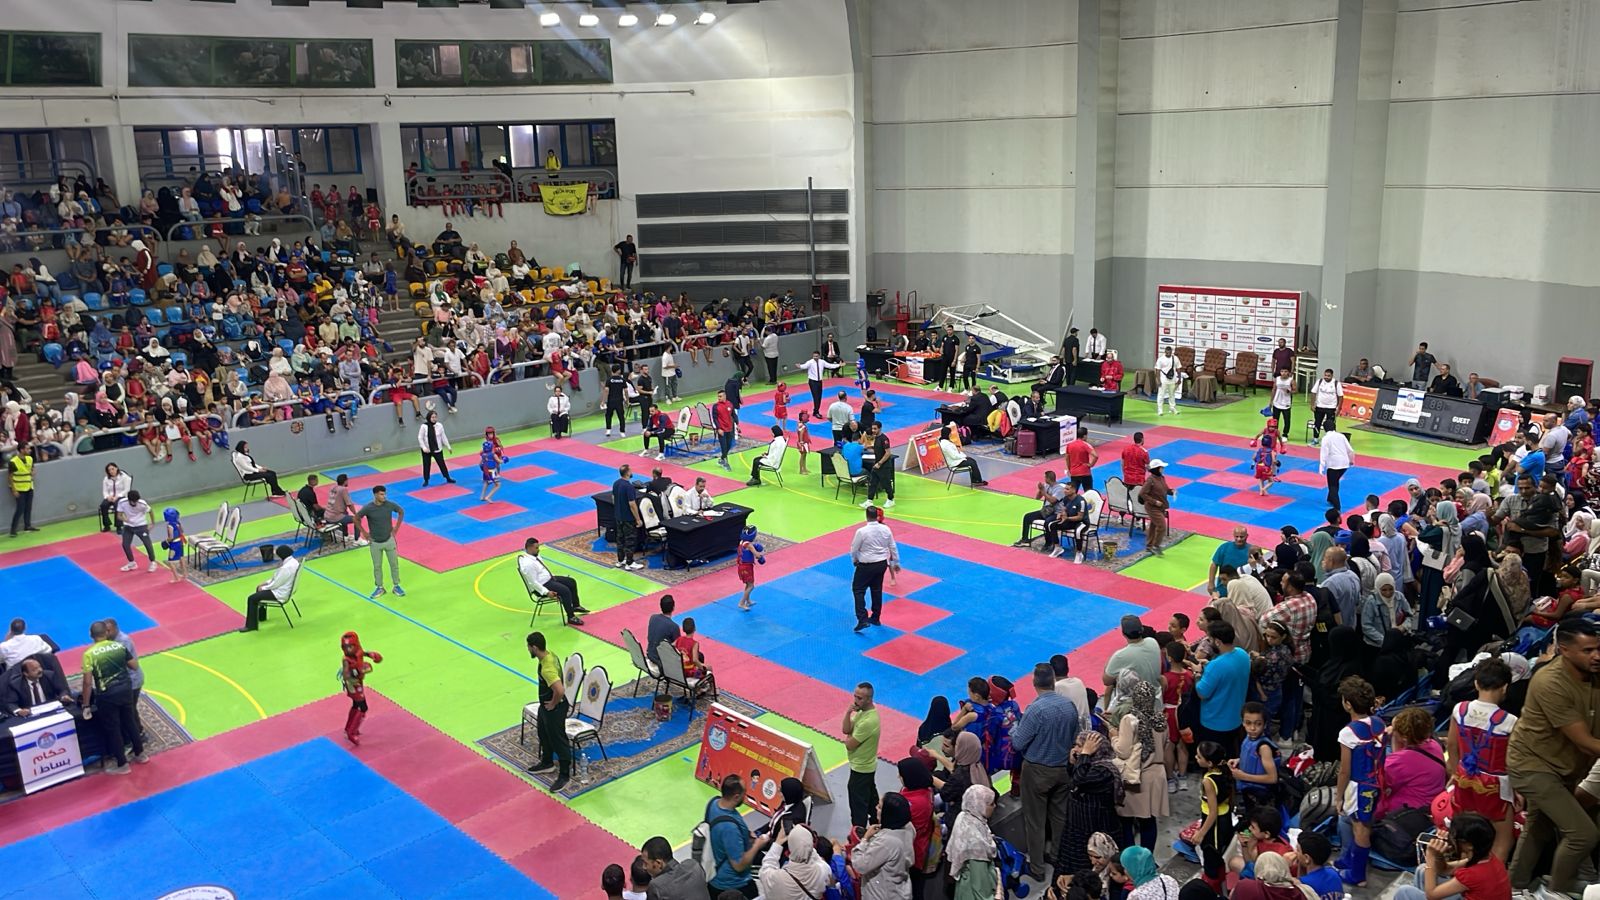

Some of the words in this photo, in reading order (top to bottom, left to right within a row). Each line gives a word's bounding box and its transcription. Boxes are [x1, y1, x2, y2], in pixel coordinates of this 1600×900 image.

[1452, 416, 1471, 425] GUEST
[33, 747, 67, 765] حكام
[40, 758, 71, 774] بساط
